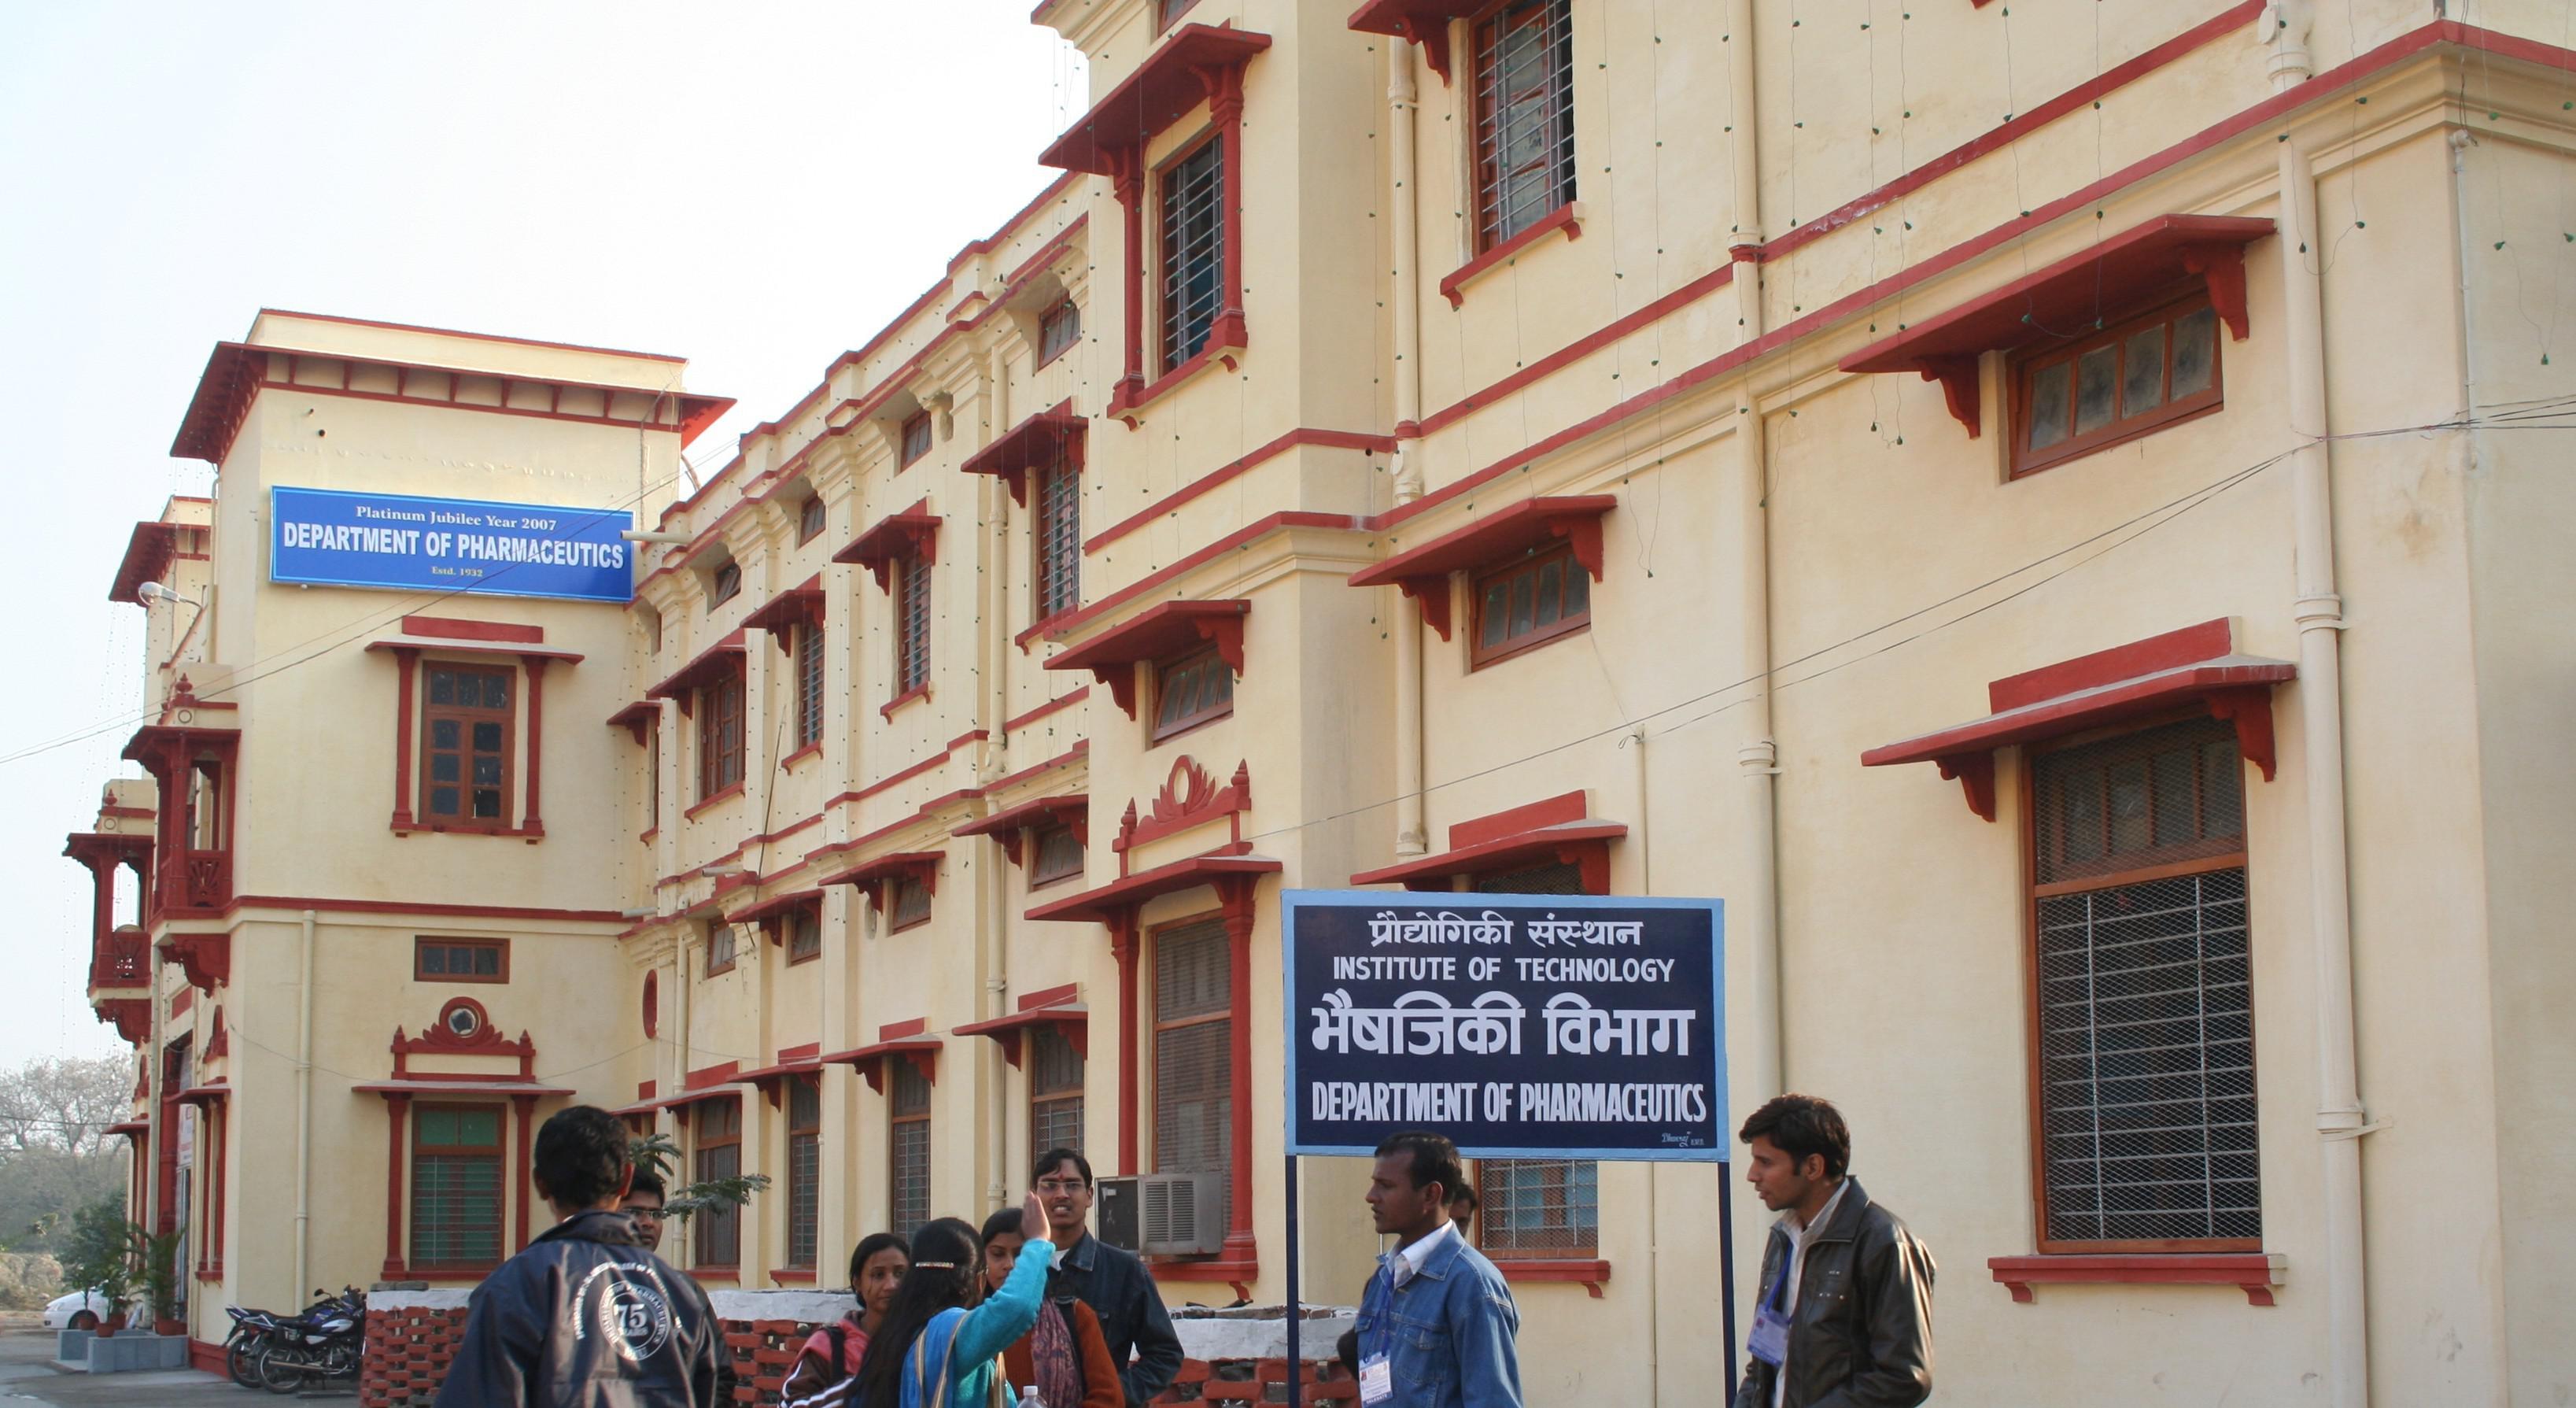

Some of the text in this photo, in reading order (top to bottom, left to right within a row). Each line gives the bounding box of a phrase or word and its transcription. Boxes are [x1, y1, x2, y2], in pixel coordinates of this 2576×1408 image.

[356, 505, 557, 531] Platinum Jubilee Year 2007
[283, 522, 625, 569] DEPARTMENT OF PHARMACEUTICS
[431, 566, 456, 576] Estd.
[1367, 910, 1644, 948] प्रौद्योगिकी संस्थान
[1333, 956, 1675, 983] INSTITUTE OF TECHNOLOGY
[1311, 988, 1696, 1056] भैषजिकी विभाग
[1312, 1081, 1707, 1122] DEPARTMENT OF PHARMACEUTICS
[614, 1303, 648, 1329] 75
